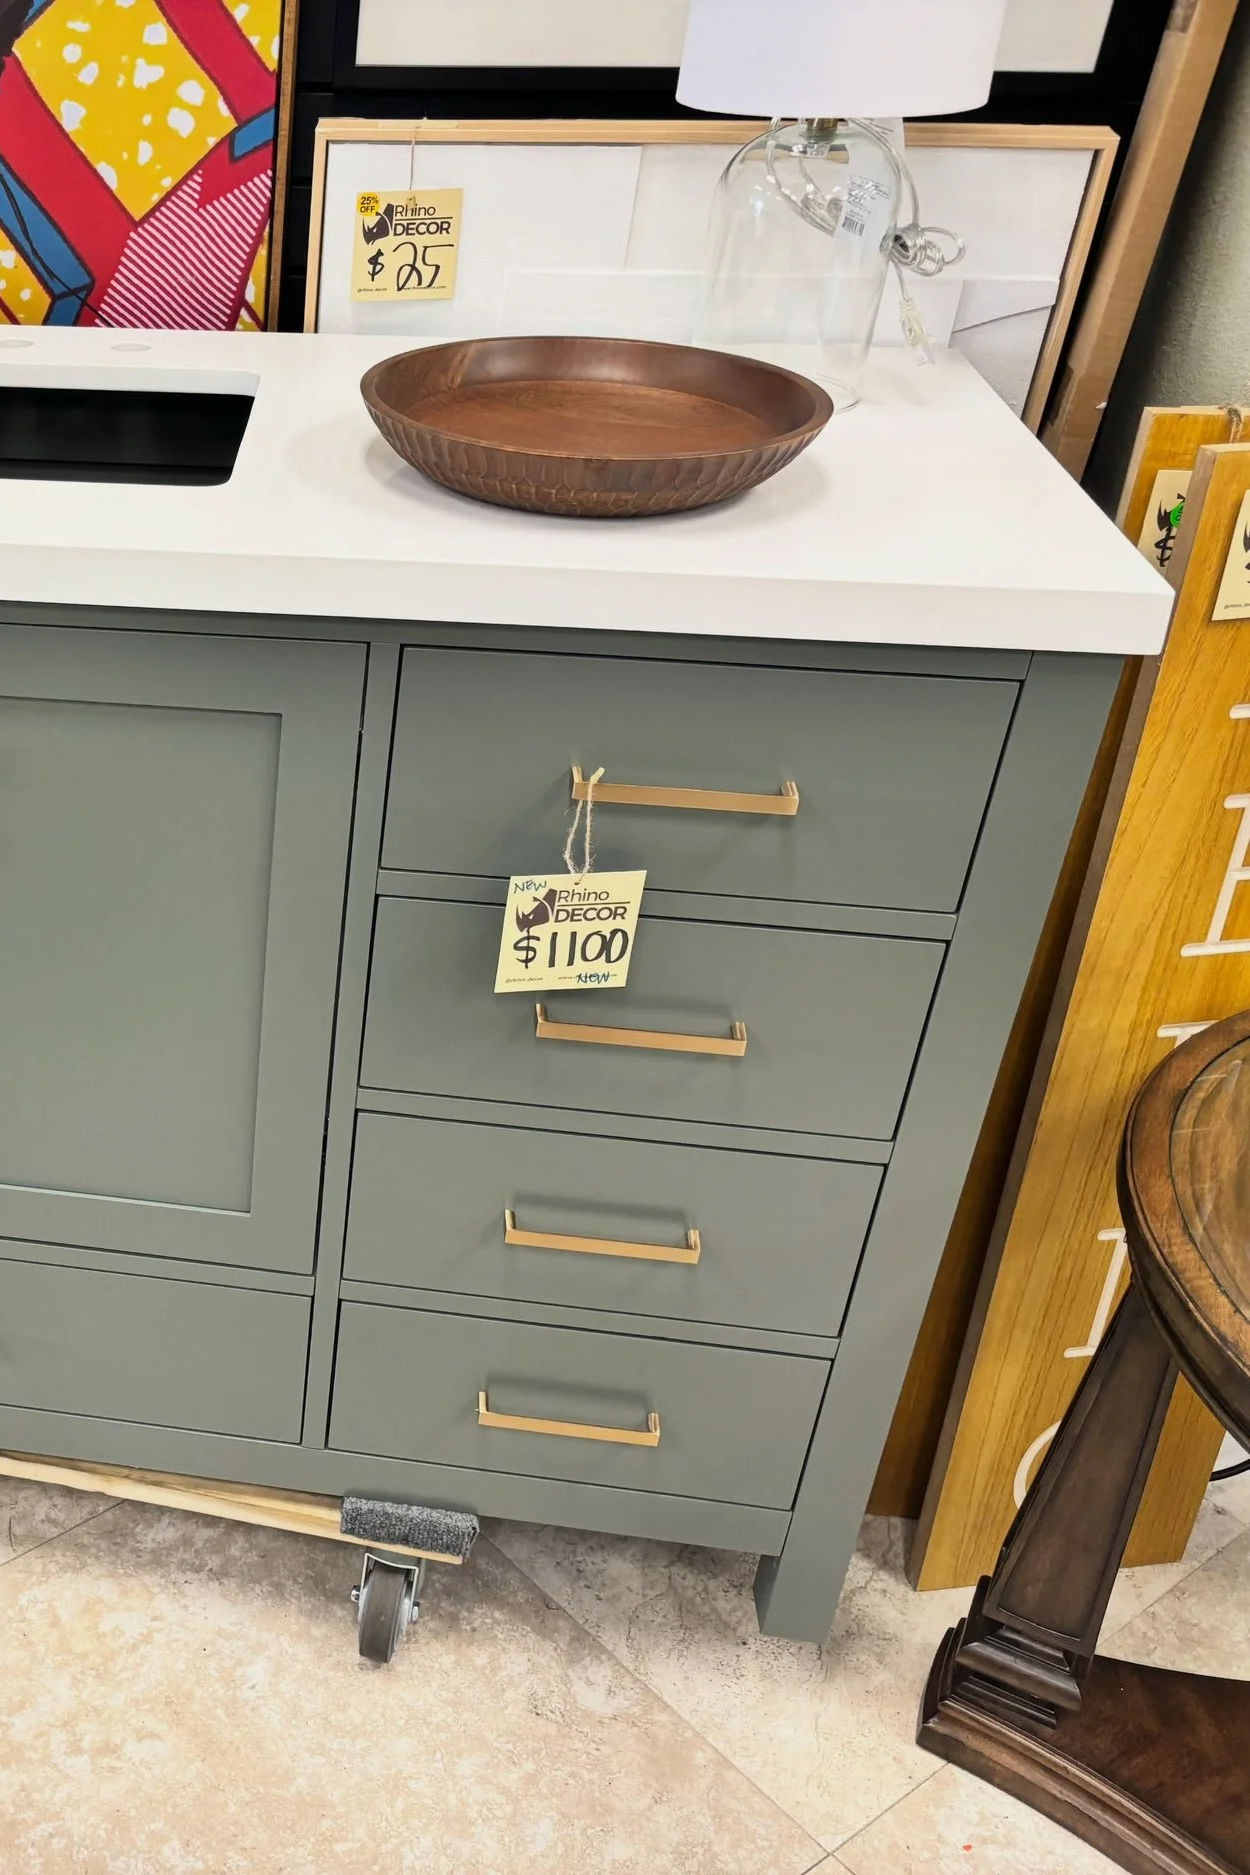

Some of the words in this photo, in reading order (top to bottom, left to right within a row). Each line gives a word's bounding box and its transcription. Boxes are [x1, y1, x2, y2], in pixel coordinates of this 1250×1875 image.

[360, 196, 379, 206] 25%
[359, 205, 376, 213] OFF
[394, 203, 437, 217] Rhino
[393, 220, 452, 237] DECOR
[513, 879, 548, 894] NEW
[557, 887, 610, 903] Rhino
[554, 905, 628, 923] DECOR
[512, 928, 630, 970] $1100
